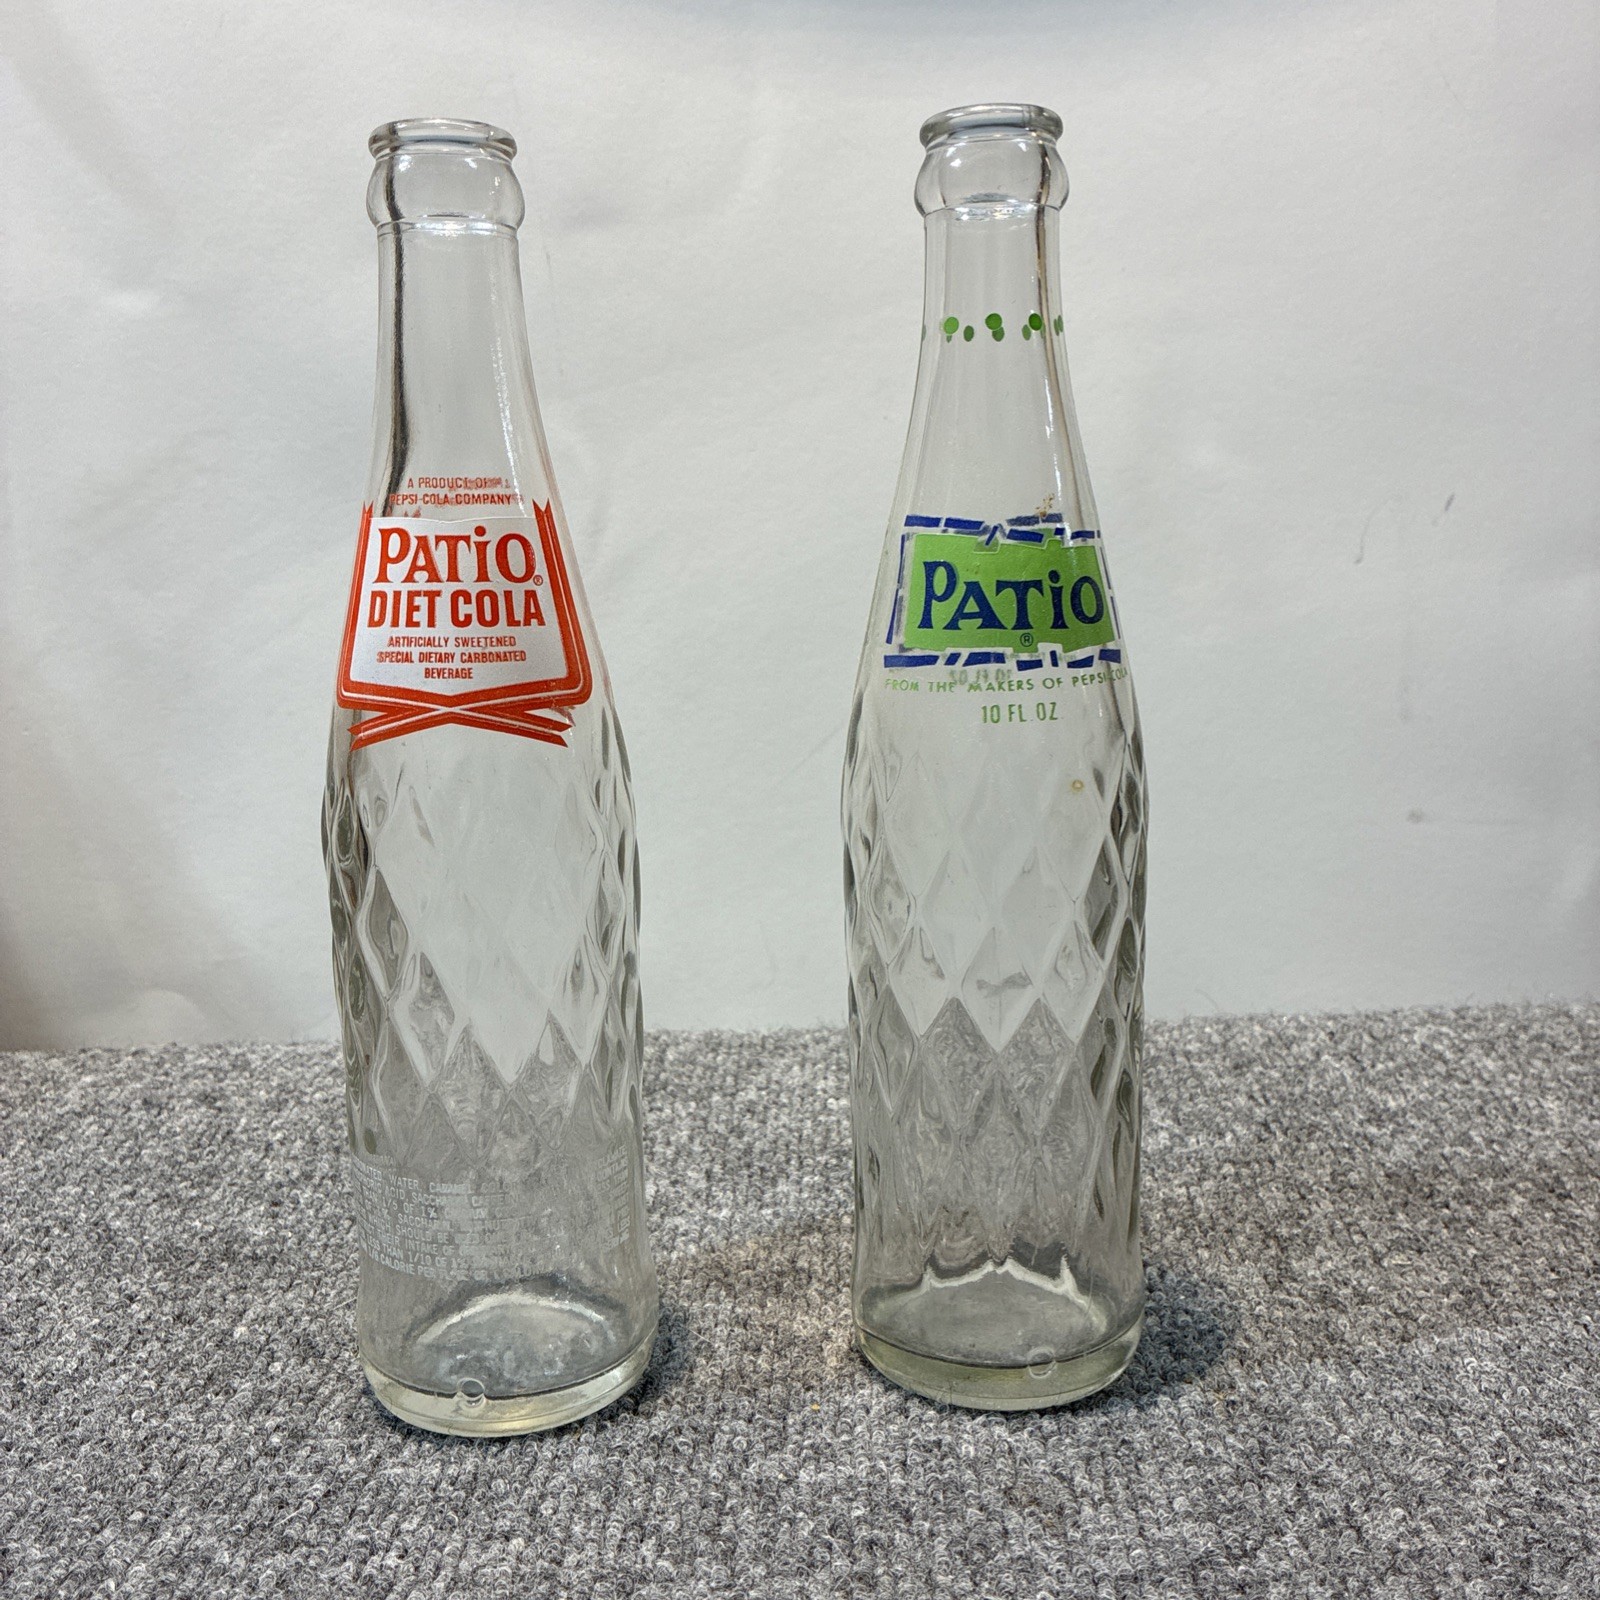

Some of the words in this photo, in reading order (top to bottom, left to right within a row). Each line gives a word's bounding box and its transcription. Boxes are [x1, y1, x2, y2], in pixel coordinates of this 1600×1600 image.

[407, 478, 414, 488] A
[418, 477, 469, 489] PRODUCT
[390, 493, 449, 505] PEPSI-COLA
[455, 493, 512, 505] COMPANY
[367, 590, 442, 628] DIET
[450, 590, 546, 628] COLA
[388, 636, 449, 648] ARTIFICIALLY
[454, 636, 516, 647] SWEETENED
[377, 652, 414, 664] SPECIAL
[418, 652, 455, 664] DIETARY
[460, 651, 526, 663] CARBONATED
[424, 668, 473, 679] BEVERAGE
[884, 679, 919, 692] FROM
[928, 681, 955, 693] THE
[967, 680, 1034, 692] MAKERS
[1042, 677, 1063, 690] OF
[982, 705, 1000, 723] 10
